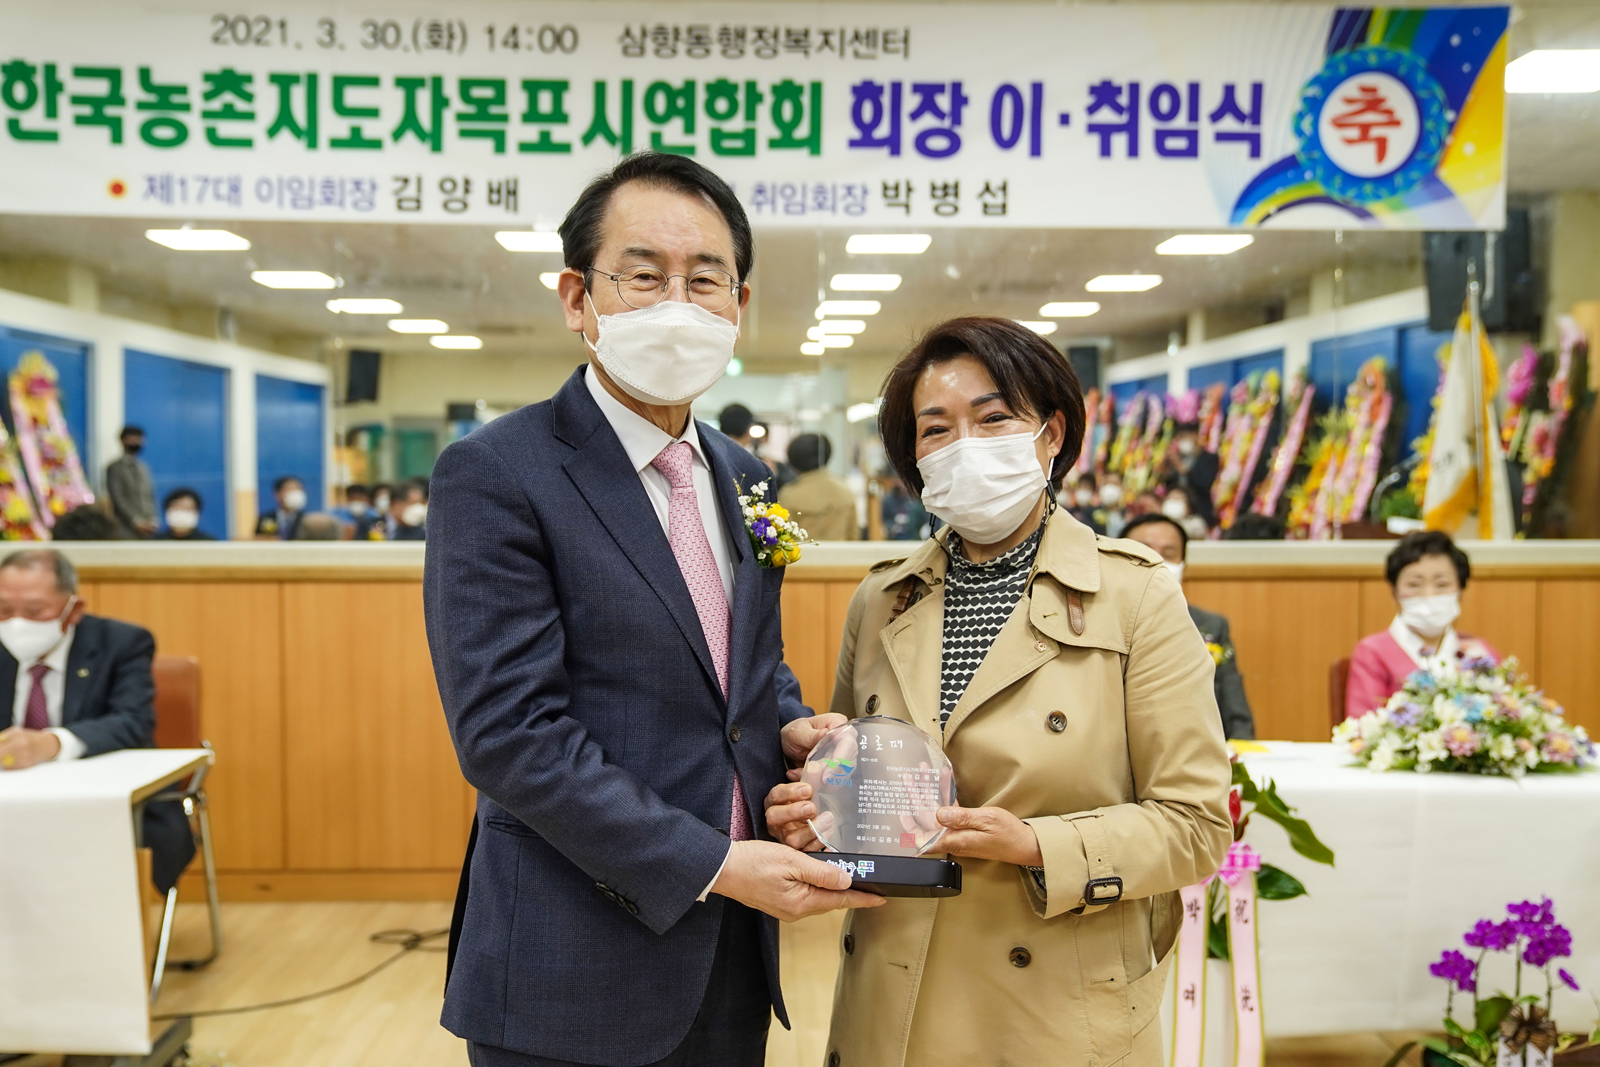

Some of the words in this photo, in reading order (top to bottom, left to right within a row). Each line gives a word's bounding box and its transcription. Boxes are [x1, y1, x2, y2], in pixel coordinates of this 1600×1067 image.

[211, 14, 302, 50] 2021.
[316, 18, 345, 50] 3.
[485, 25, 578, 52] 14:00
[619, 25, 909, 59] 삼향동행정복지센터
[1, 60, 822, 157] 한국농촌지도자목포시연합회
[848, 81, 968, 158] 회장
[1331, 85, 1401, 164] 축
[143, 174, 242, 207] 제17대
[255, 175, 377, 212] 이임회장
[392, 177, 422, 212] 김
[440, 176, 470, 212] 양
[488, 178, 519, 213] 배
[751, 183, 868, 216] 취임회장
[882, 181, 914, 215] 박
[930, 181, 960, 216] 병
[977, 182, 1008, 216] 섭
[857, 860, 874, 878] 목포
